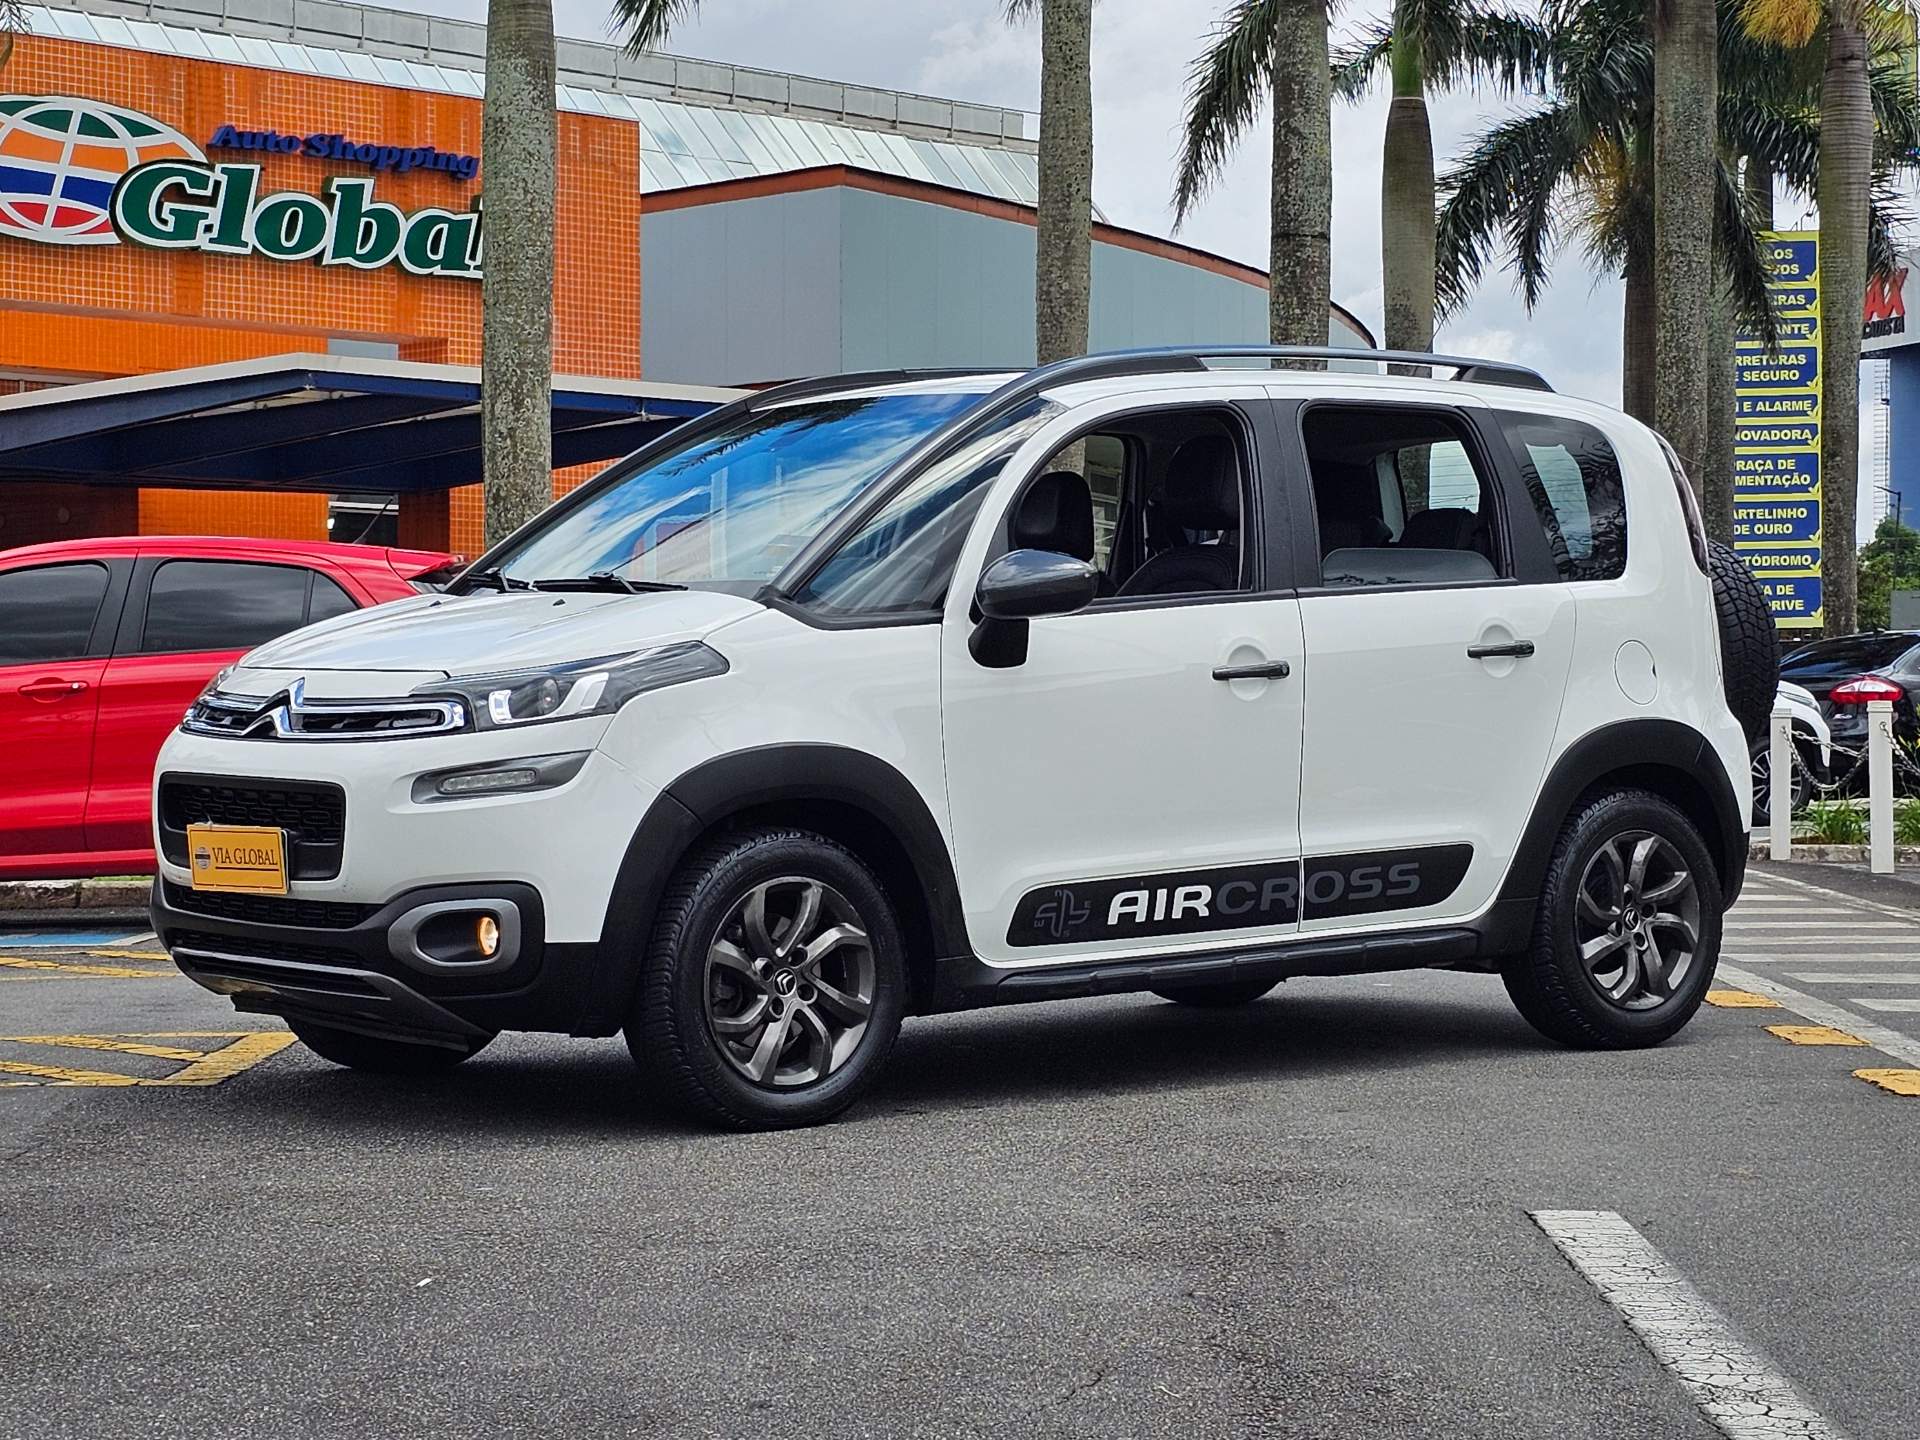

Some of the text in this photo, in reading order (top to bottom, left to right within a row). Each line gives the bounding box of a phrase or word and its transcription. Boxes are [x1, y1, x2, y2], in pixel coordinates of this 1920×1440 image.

[206, 124, 480, 180] Auto Shopping
[116, 163, 483, 279] Globa
[1743, 370, 1800, 381] SEGURO
[1743, 401, 1752, 412] E
[1756, 400, 1812, 412] ALARME
[1777, 459, 1796, 470] DE
[1734, 523, 1793, 535] DE OURO
[1776, 584, 1795, 596] DE
[1768, 599, 1805, 611] RIVE
[212, 847, 279, 866] VIA GLOBAL
[1107, 862, 1420, 925] AIRCROSS
